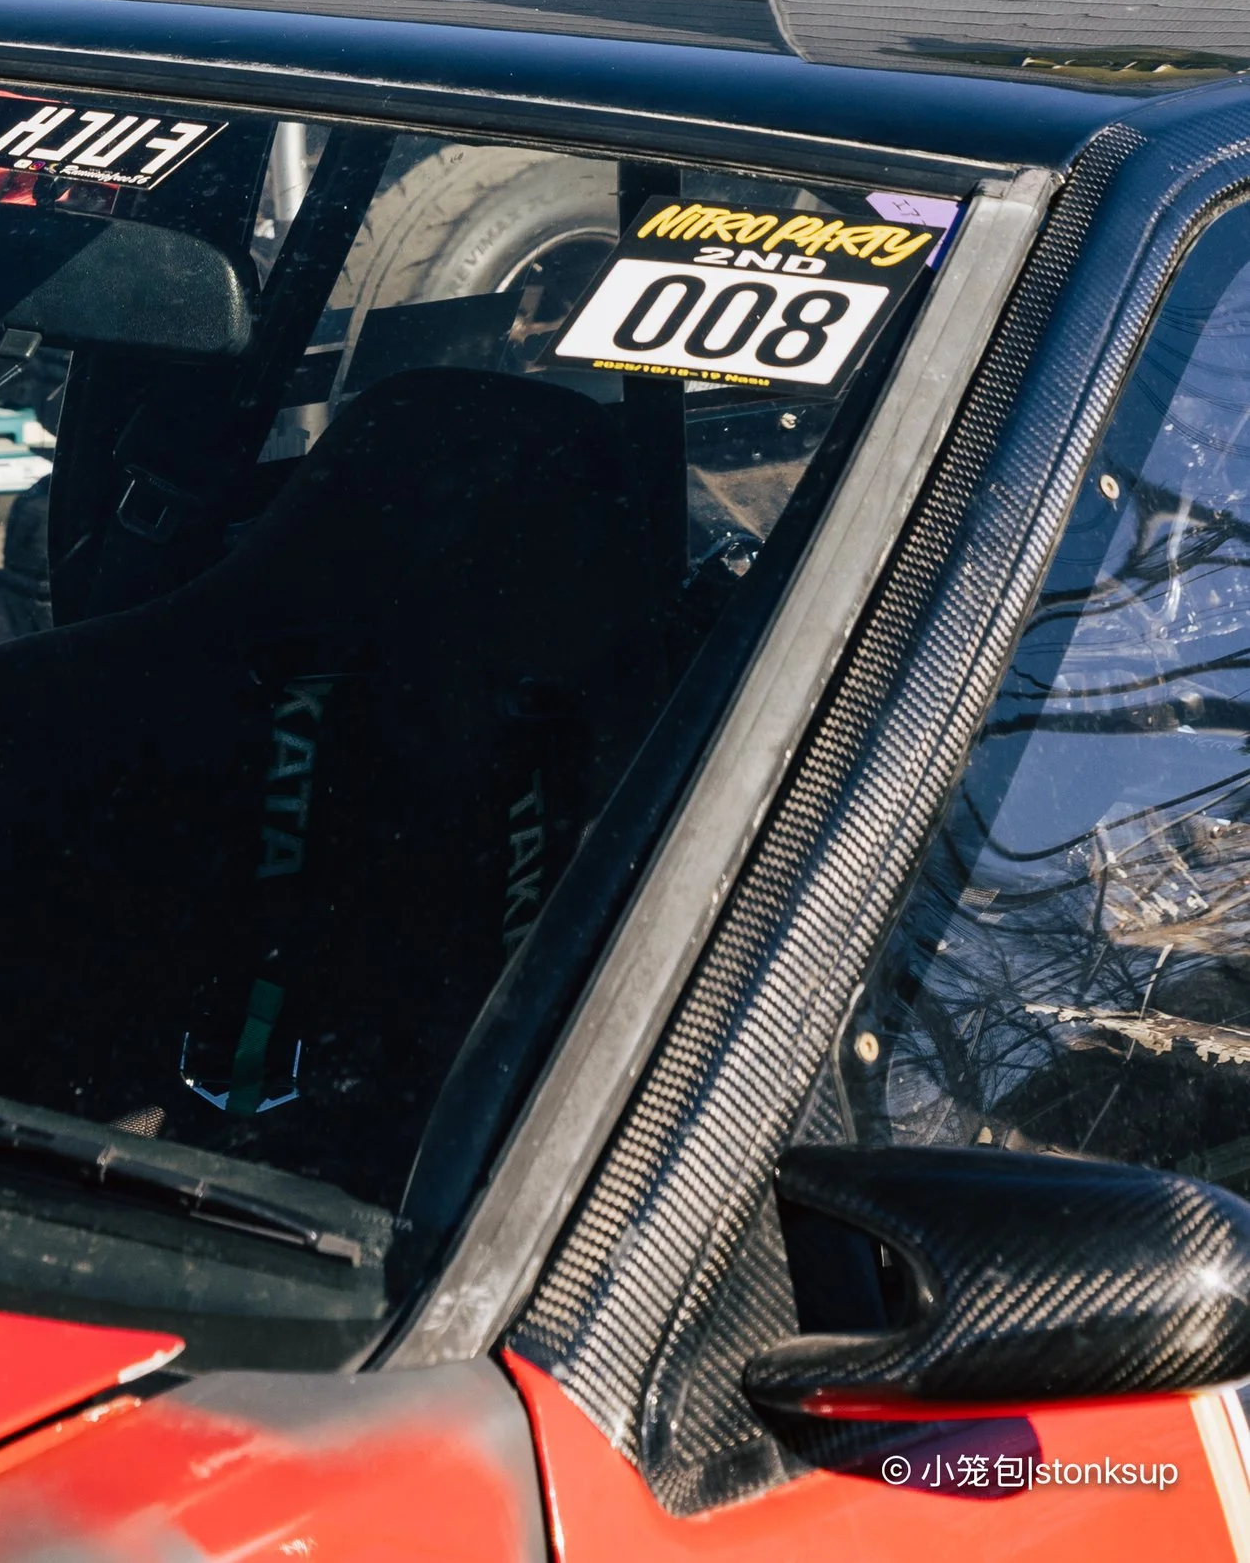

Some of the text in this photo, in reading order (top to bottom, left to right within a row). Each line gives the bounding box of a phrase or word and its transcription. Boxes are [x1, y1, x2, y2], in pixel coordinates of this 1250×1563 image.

[693, 247, 827, 276] 2ND
[762, 214, 932, 267] PARTY
[612, 274, 851, 368] 008
